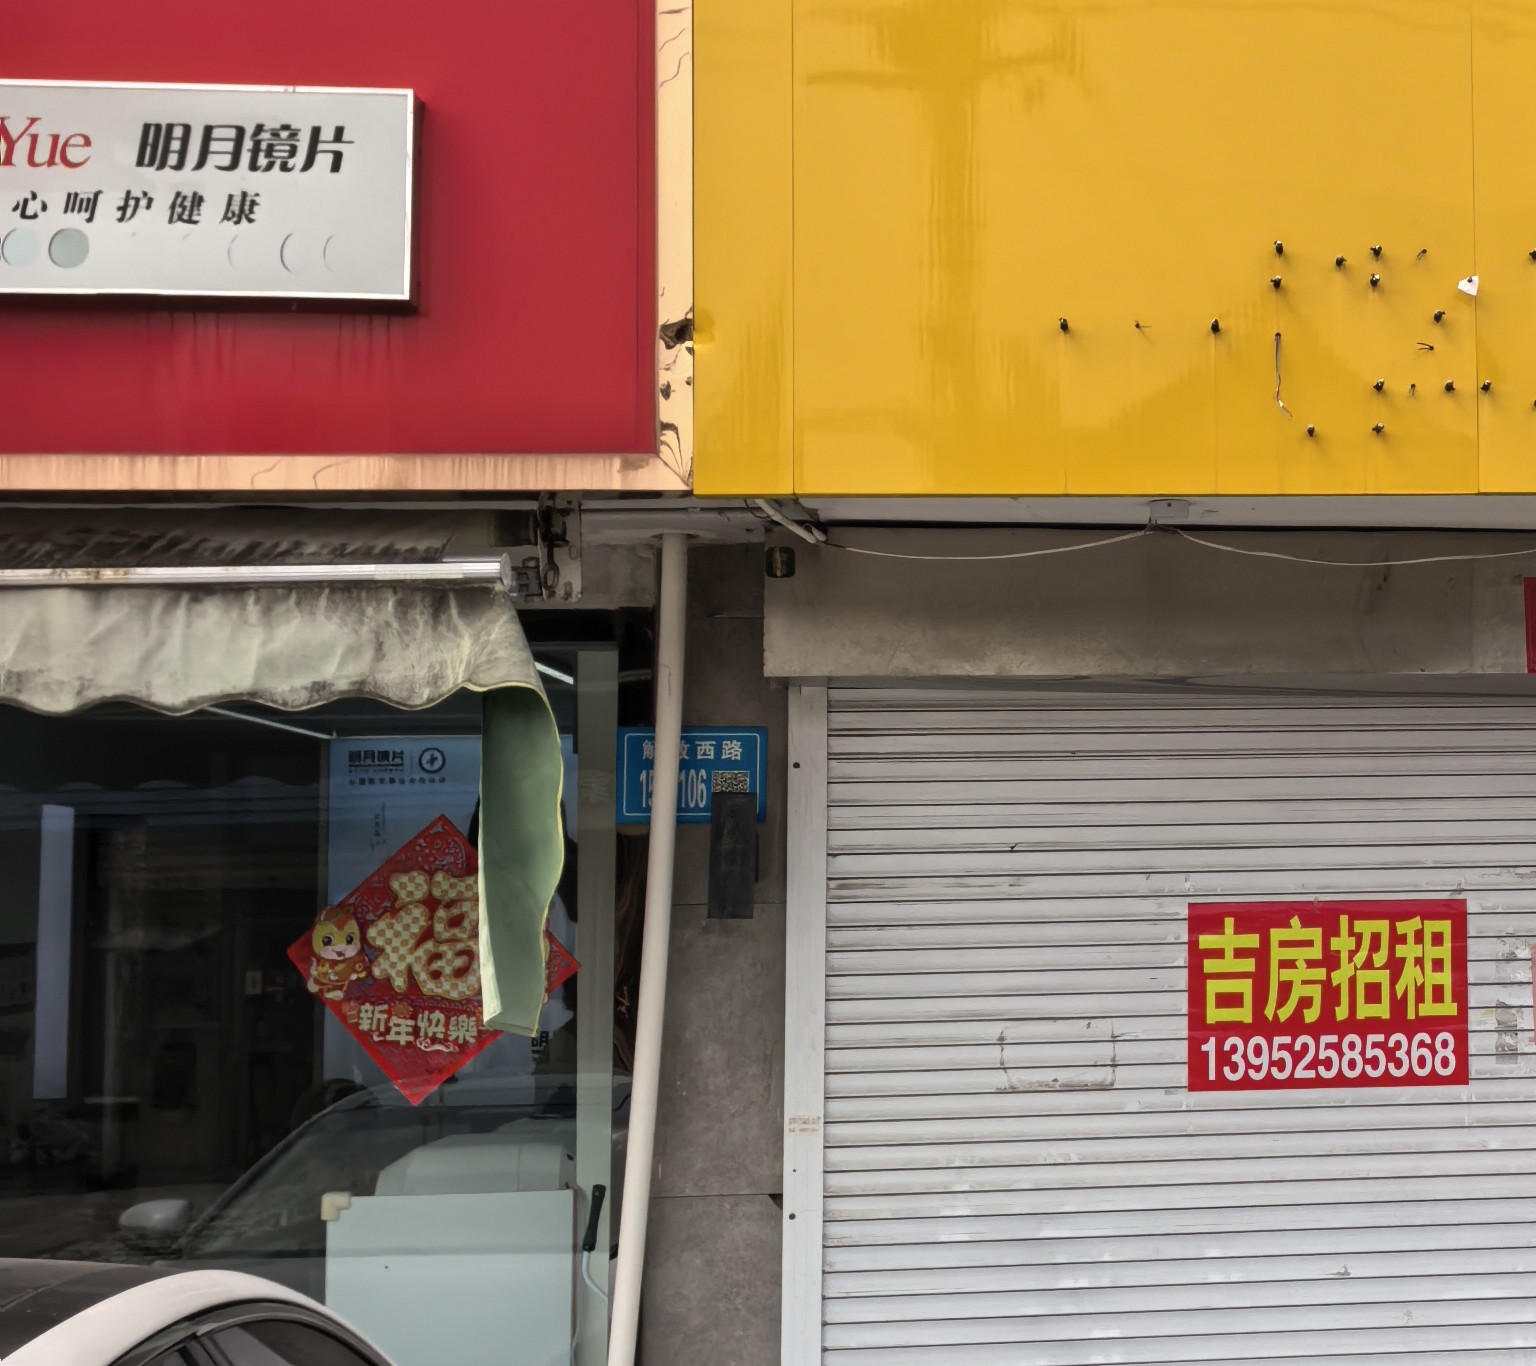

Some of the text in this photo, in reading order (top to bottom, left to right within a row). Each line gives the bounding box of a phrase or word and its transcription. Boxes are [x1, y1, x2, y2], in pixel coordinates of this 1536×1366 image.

[135, 122, 355, 173] 明月镜片
[11, 189, 261, 225] 心呵护健康
[1198, 915, 1458, 1024] 吉房招租
[359, 1002, 478, 1046] 新年快樂
[1200, 1032, 1456, 1081] 13952585368
